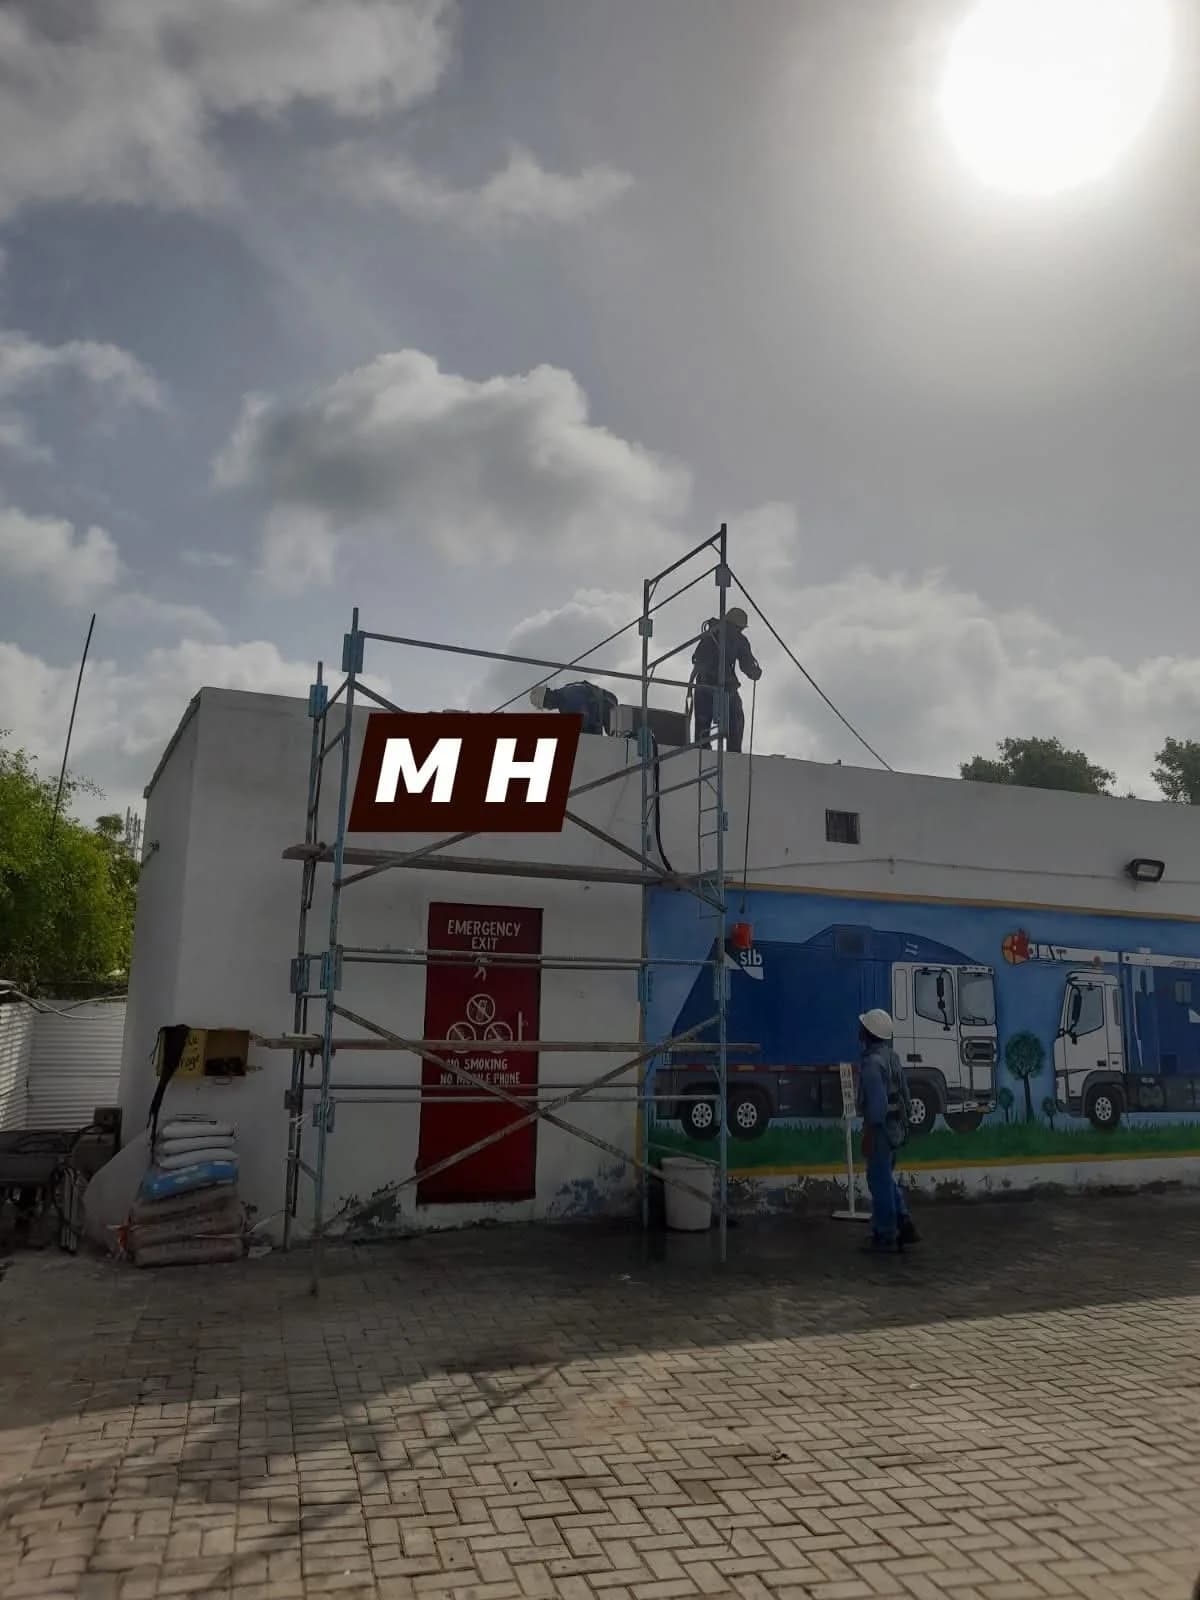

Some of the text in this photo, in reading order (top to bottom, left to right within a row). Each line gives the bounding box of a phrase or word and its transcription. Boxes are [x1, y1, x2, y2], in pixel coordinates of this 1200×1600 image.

[447, 919, 521, 937] EMERGENCY
[471, 936, 499, 951] EXIT
[464, 1058, 508, 1071] SMOKING
[440, 1072, 454, 1085] NO
[494, 1072, 520, 1085] PHONE
